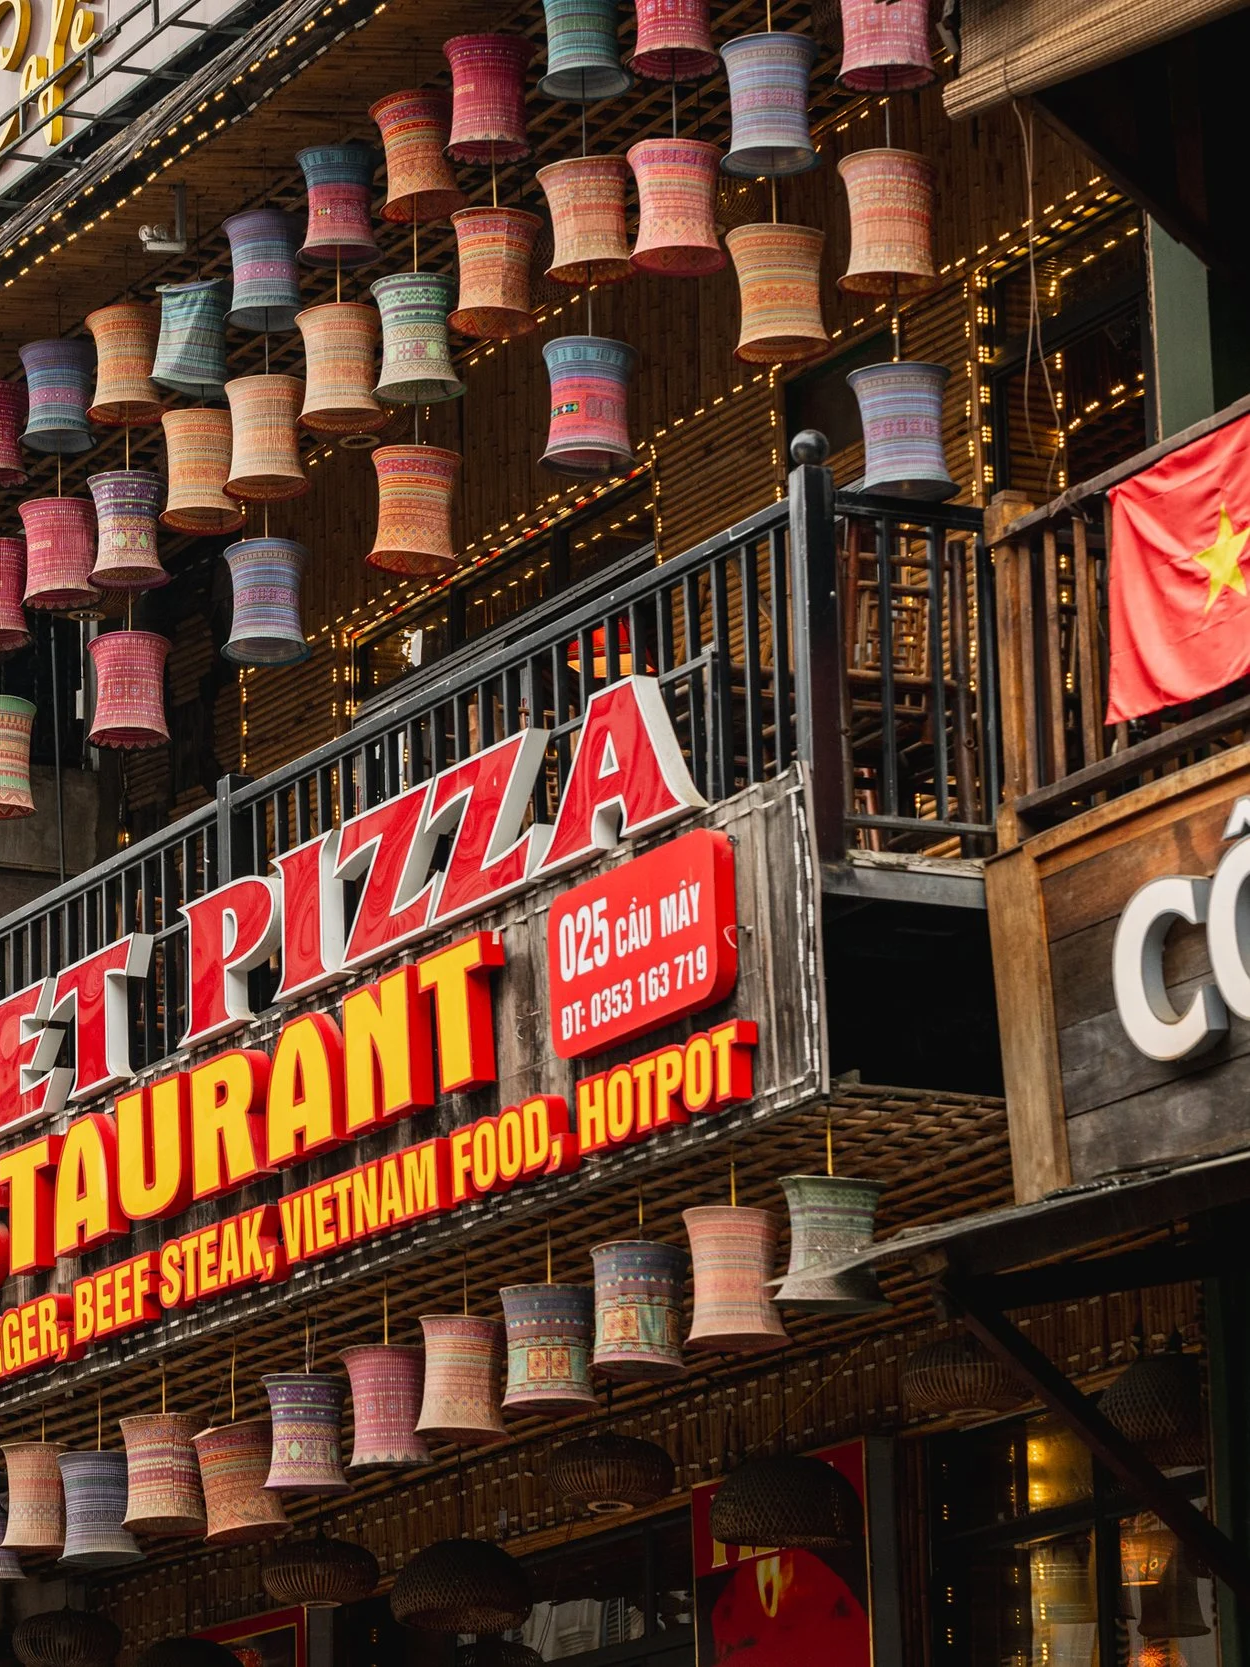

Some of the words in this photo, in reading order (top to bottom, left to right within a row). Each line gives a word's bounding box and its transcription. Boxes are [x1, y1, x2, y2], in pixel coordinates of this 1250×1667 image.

[178, 675, 707, 1048] PIZZA
[559, 897, 610, 982] 025
[615, 897, 651, 957] CẦU
[660, 880, 701, 938] MÂY
[561, 1000, 587, 1040] ĐT:
[590, 979, 633, 1027] 0353
[638, 966, 670, 1006] 163
[674, 945, 707, 990] 719
[74, 1252, 159, 1344] BEEF
[159, 1205, 278, 1309] STEAK,
[279, 1139, 447, 1264] VIETNAM
[450, 1095, 568, 1203] FOOD,
[576, 1019, 750, 1154] HOTPOT
